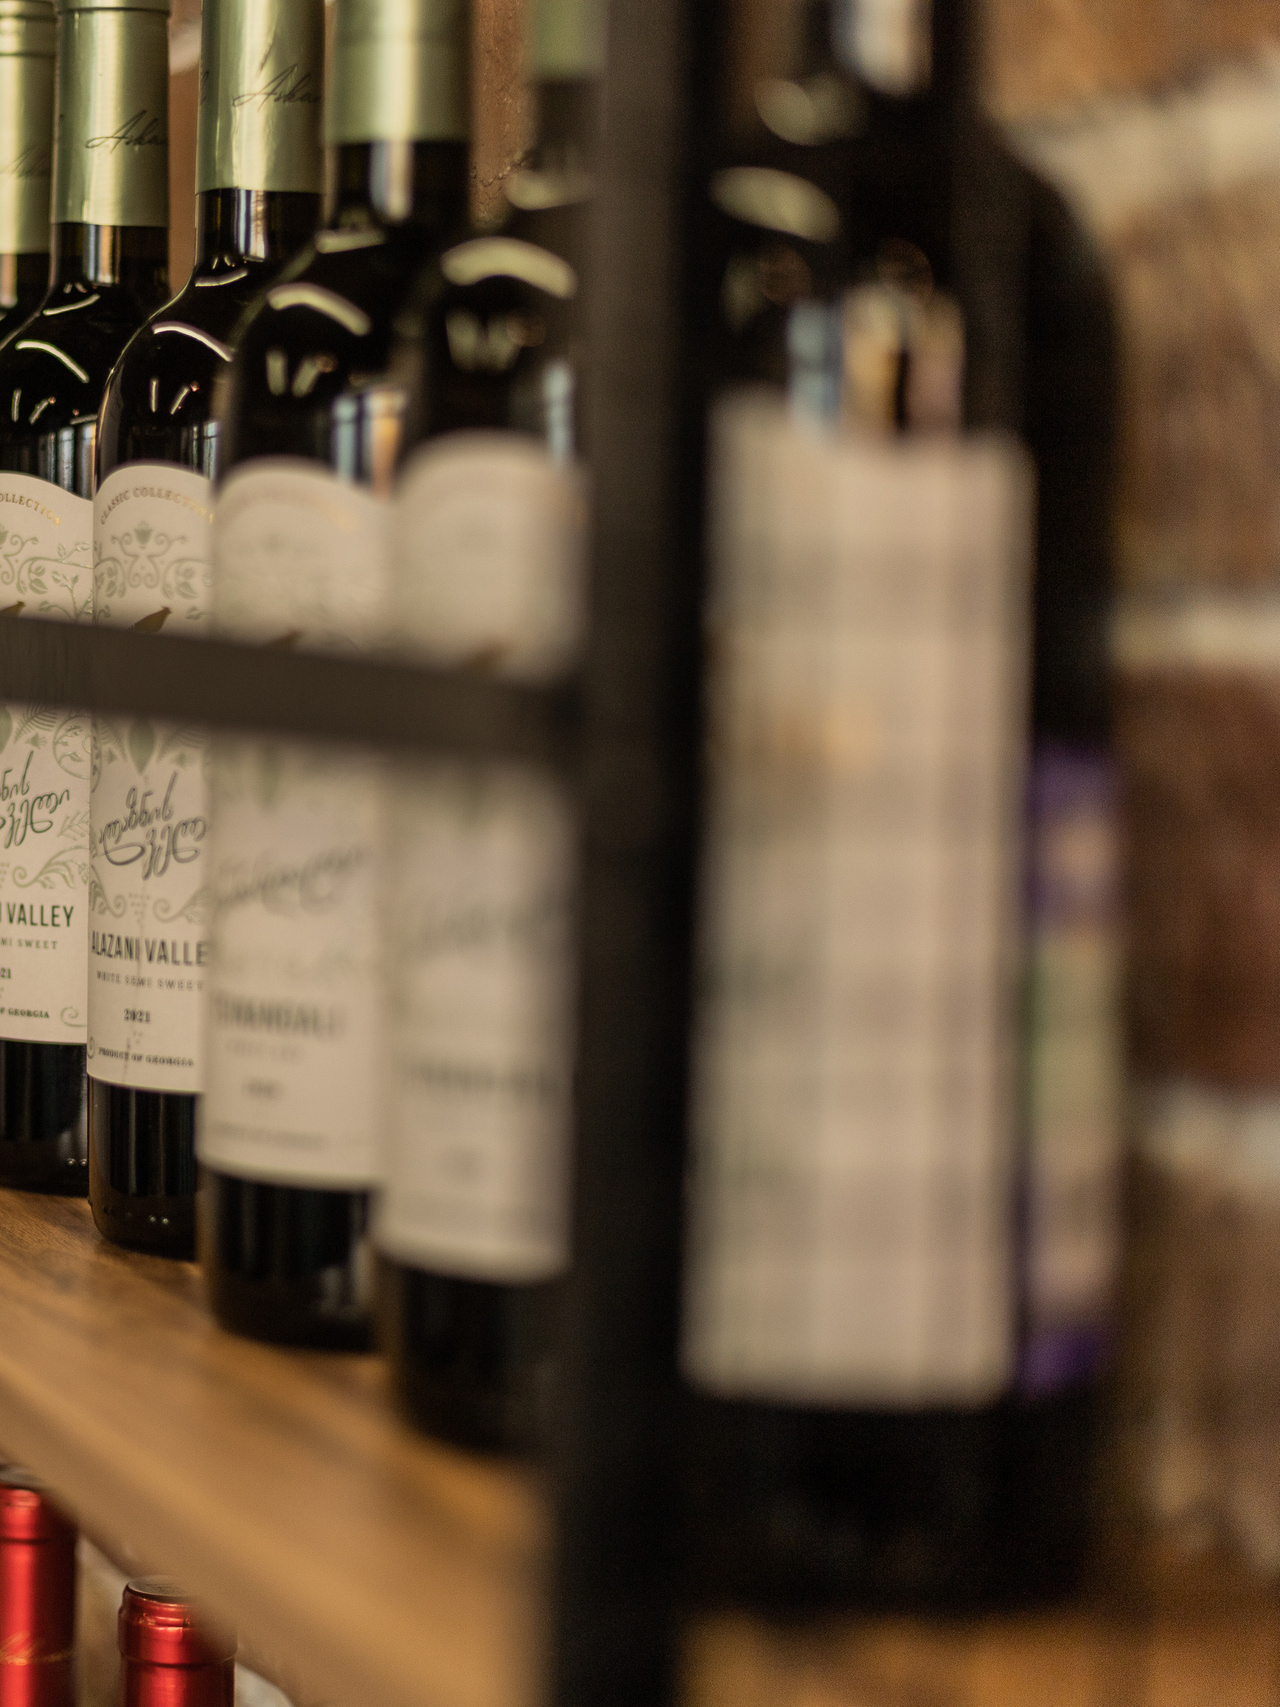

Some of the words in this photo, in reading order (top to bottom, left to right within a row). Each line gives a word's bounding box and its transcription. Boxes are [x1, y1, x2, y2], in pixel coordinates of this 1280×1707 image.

[7, 902, 74, 928] VALLEY
[17, 938, 58, 950] SWEET
[145, 938, 208, 967] VALLE
[124, 974, 152, 988] SEMI
[157, 978, 203, 990] SWEET
[8, 1007, 50, 1019] GEORGIA
[123, 1008, 151, 1024] 2021
[98, 1046, 130, 1060] PRODUCT
[131, 1052, 143, 1062] OF
[145, 1054, 194, 1067] GEORGIA
